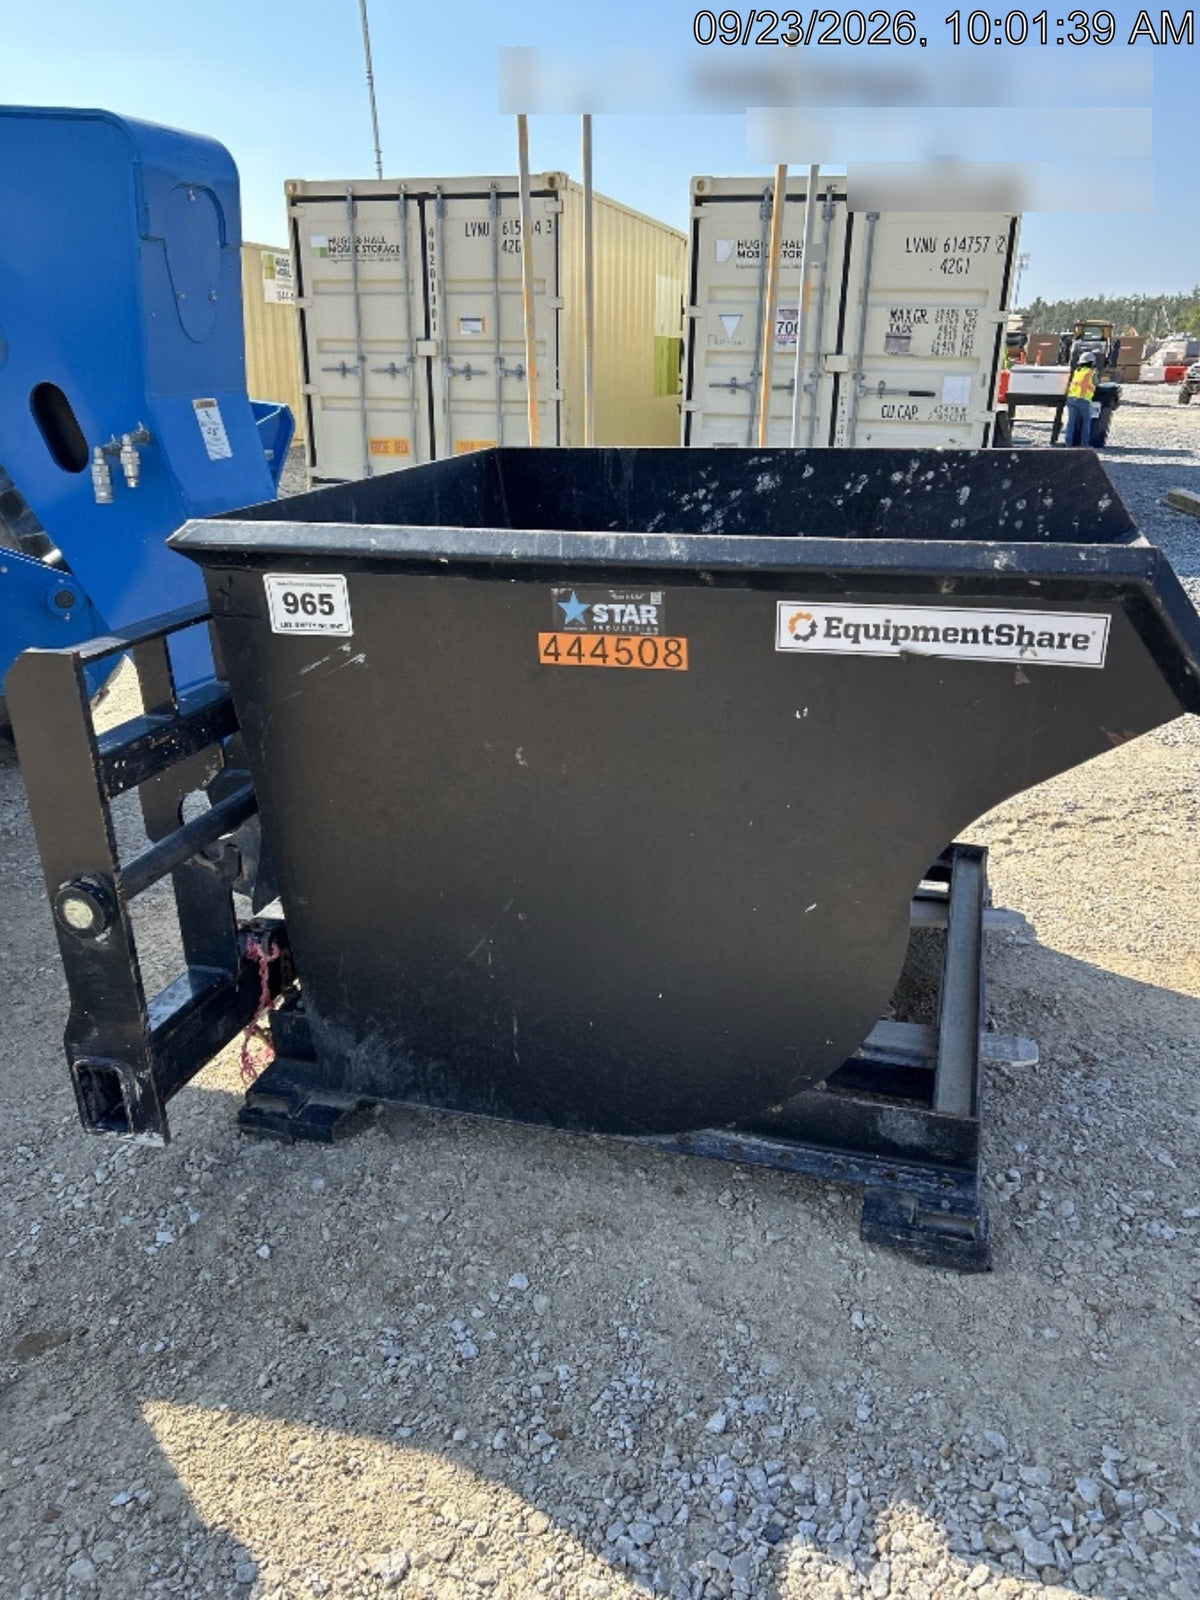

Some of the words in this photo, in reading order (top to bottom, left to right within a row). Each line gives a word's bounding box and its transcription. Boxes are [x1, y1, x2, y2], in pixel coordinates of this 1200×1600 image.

[905, 236, 936, 254] LVNU
[943, 236, 991, 254] 614757
[940, 257, 971, 275] 42G1
[282, 592, 335, 616] 965
[592, 603, 659, 625] STAR
[822, 616, 1091, 651] EquipmentShare
[543, 634, 683, 668] 444508
